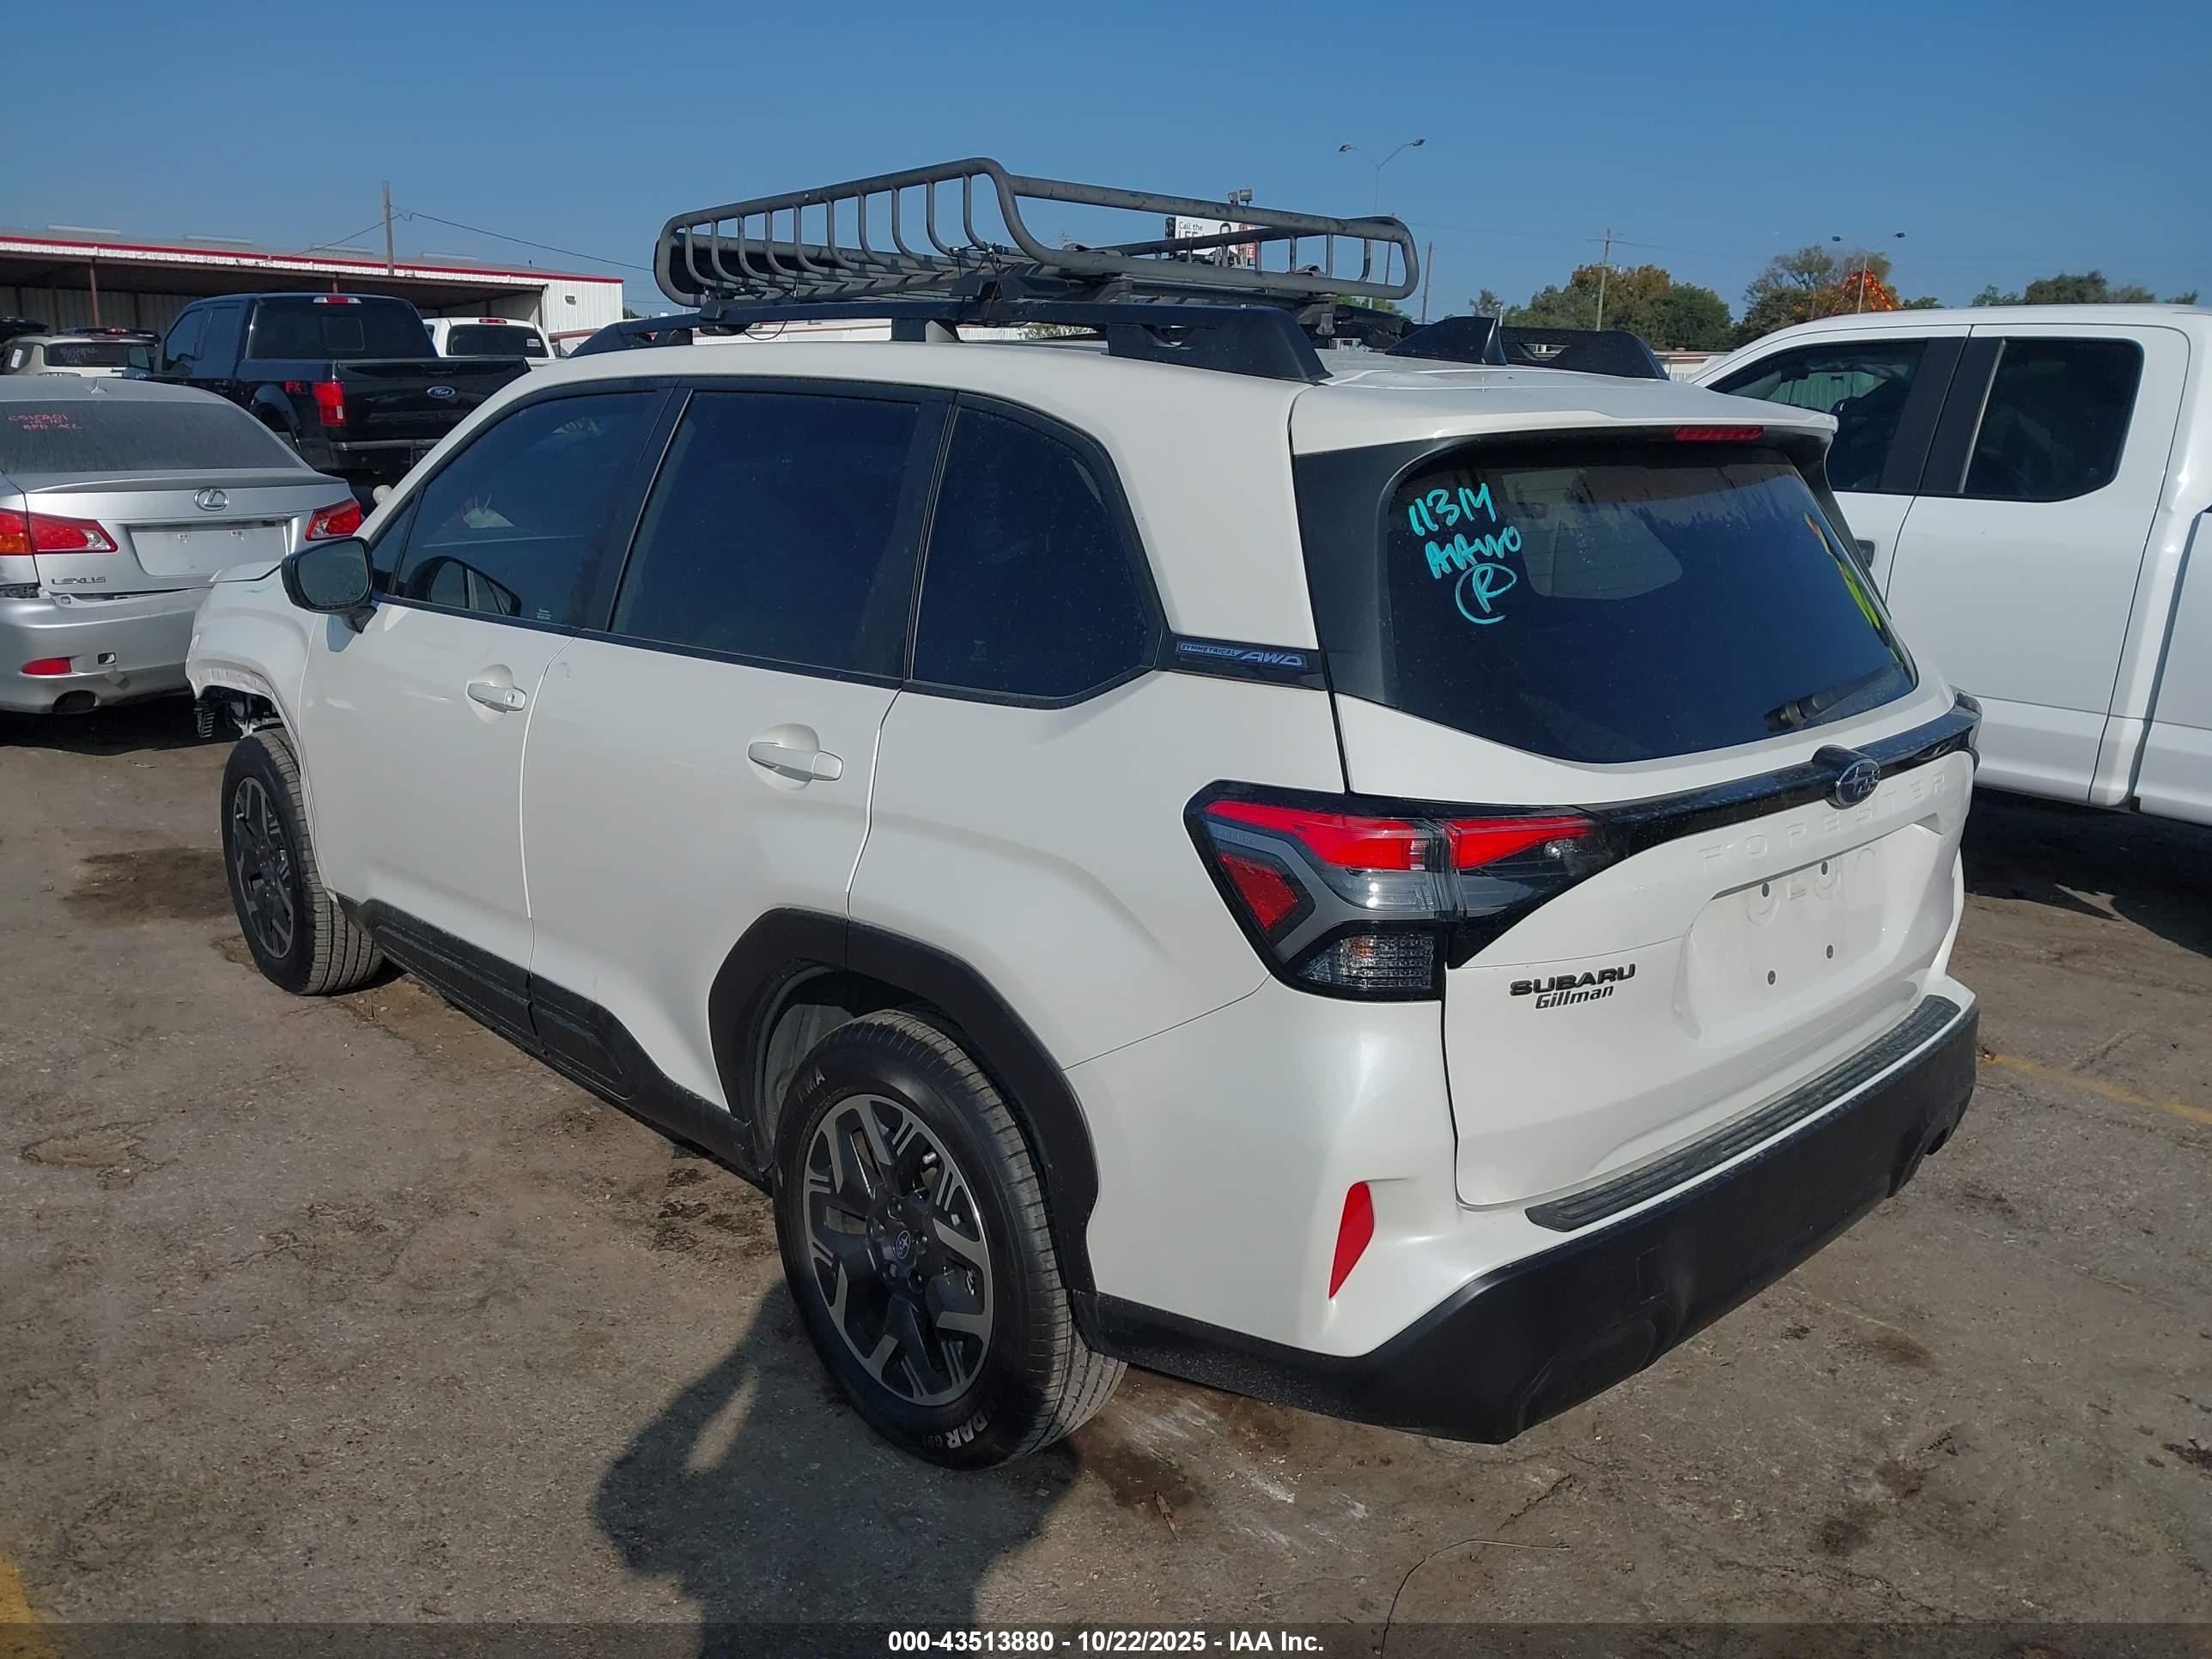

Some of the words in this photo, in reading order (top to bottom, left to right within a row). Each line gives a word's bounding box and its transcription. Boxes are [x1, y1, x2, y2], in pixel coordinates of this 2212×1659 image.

[1178, 221, 1191, 230] Call
[1193, 222, 1204, 232] the
[51, 575, 106, 586] LEXUS
[1180, 643, 1237, 656] SYMMETRICAL
[1240, 651, 1304, 667] AWD
[1510, 963, 1636, 997] SUBARU
[1535, 985, 1614, 1010] Gillman
